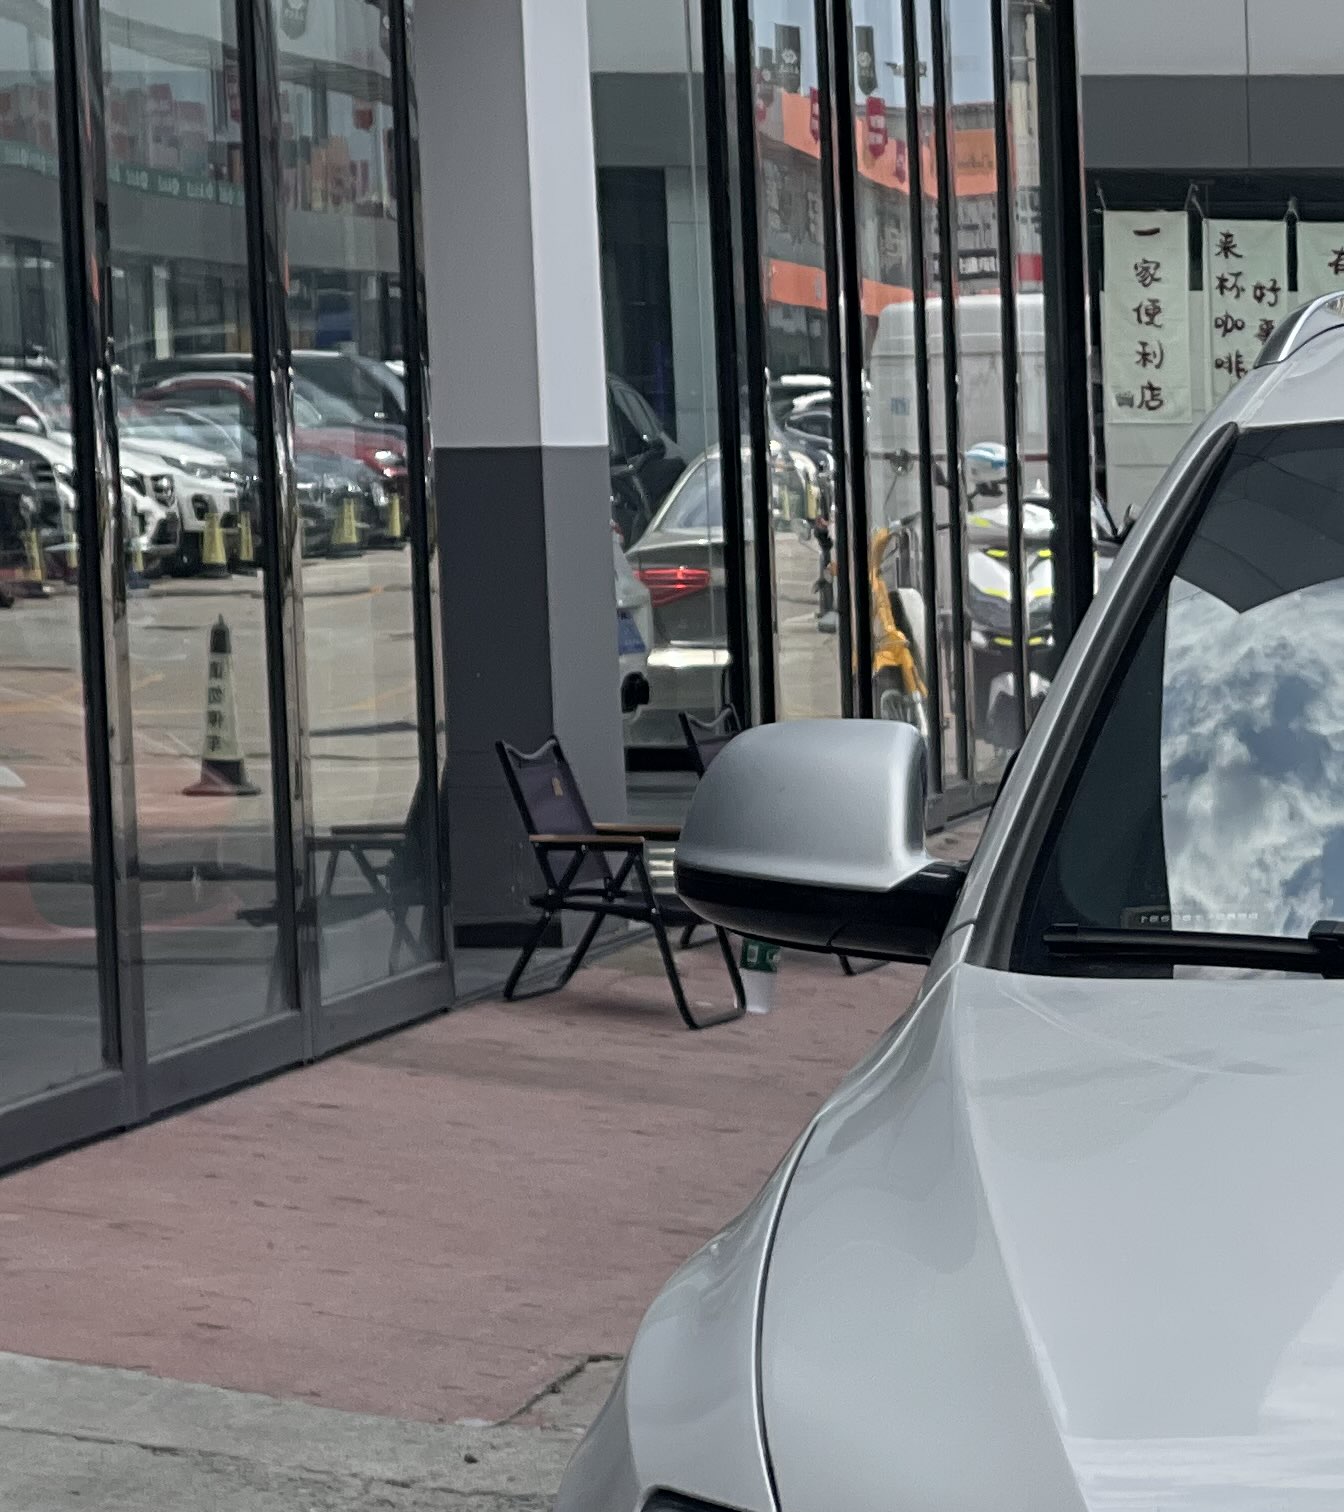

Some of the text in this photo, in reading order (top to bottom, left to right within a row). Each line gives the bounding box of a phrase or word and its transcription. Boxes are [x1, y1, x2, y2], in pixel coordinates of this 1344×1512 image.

[1132, 227, 1165, 410] 一家便利店
[1214, 230, 1248, 380] 来杯咖啡
